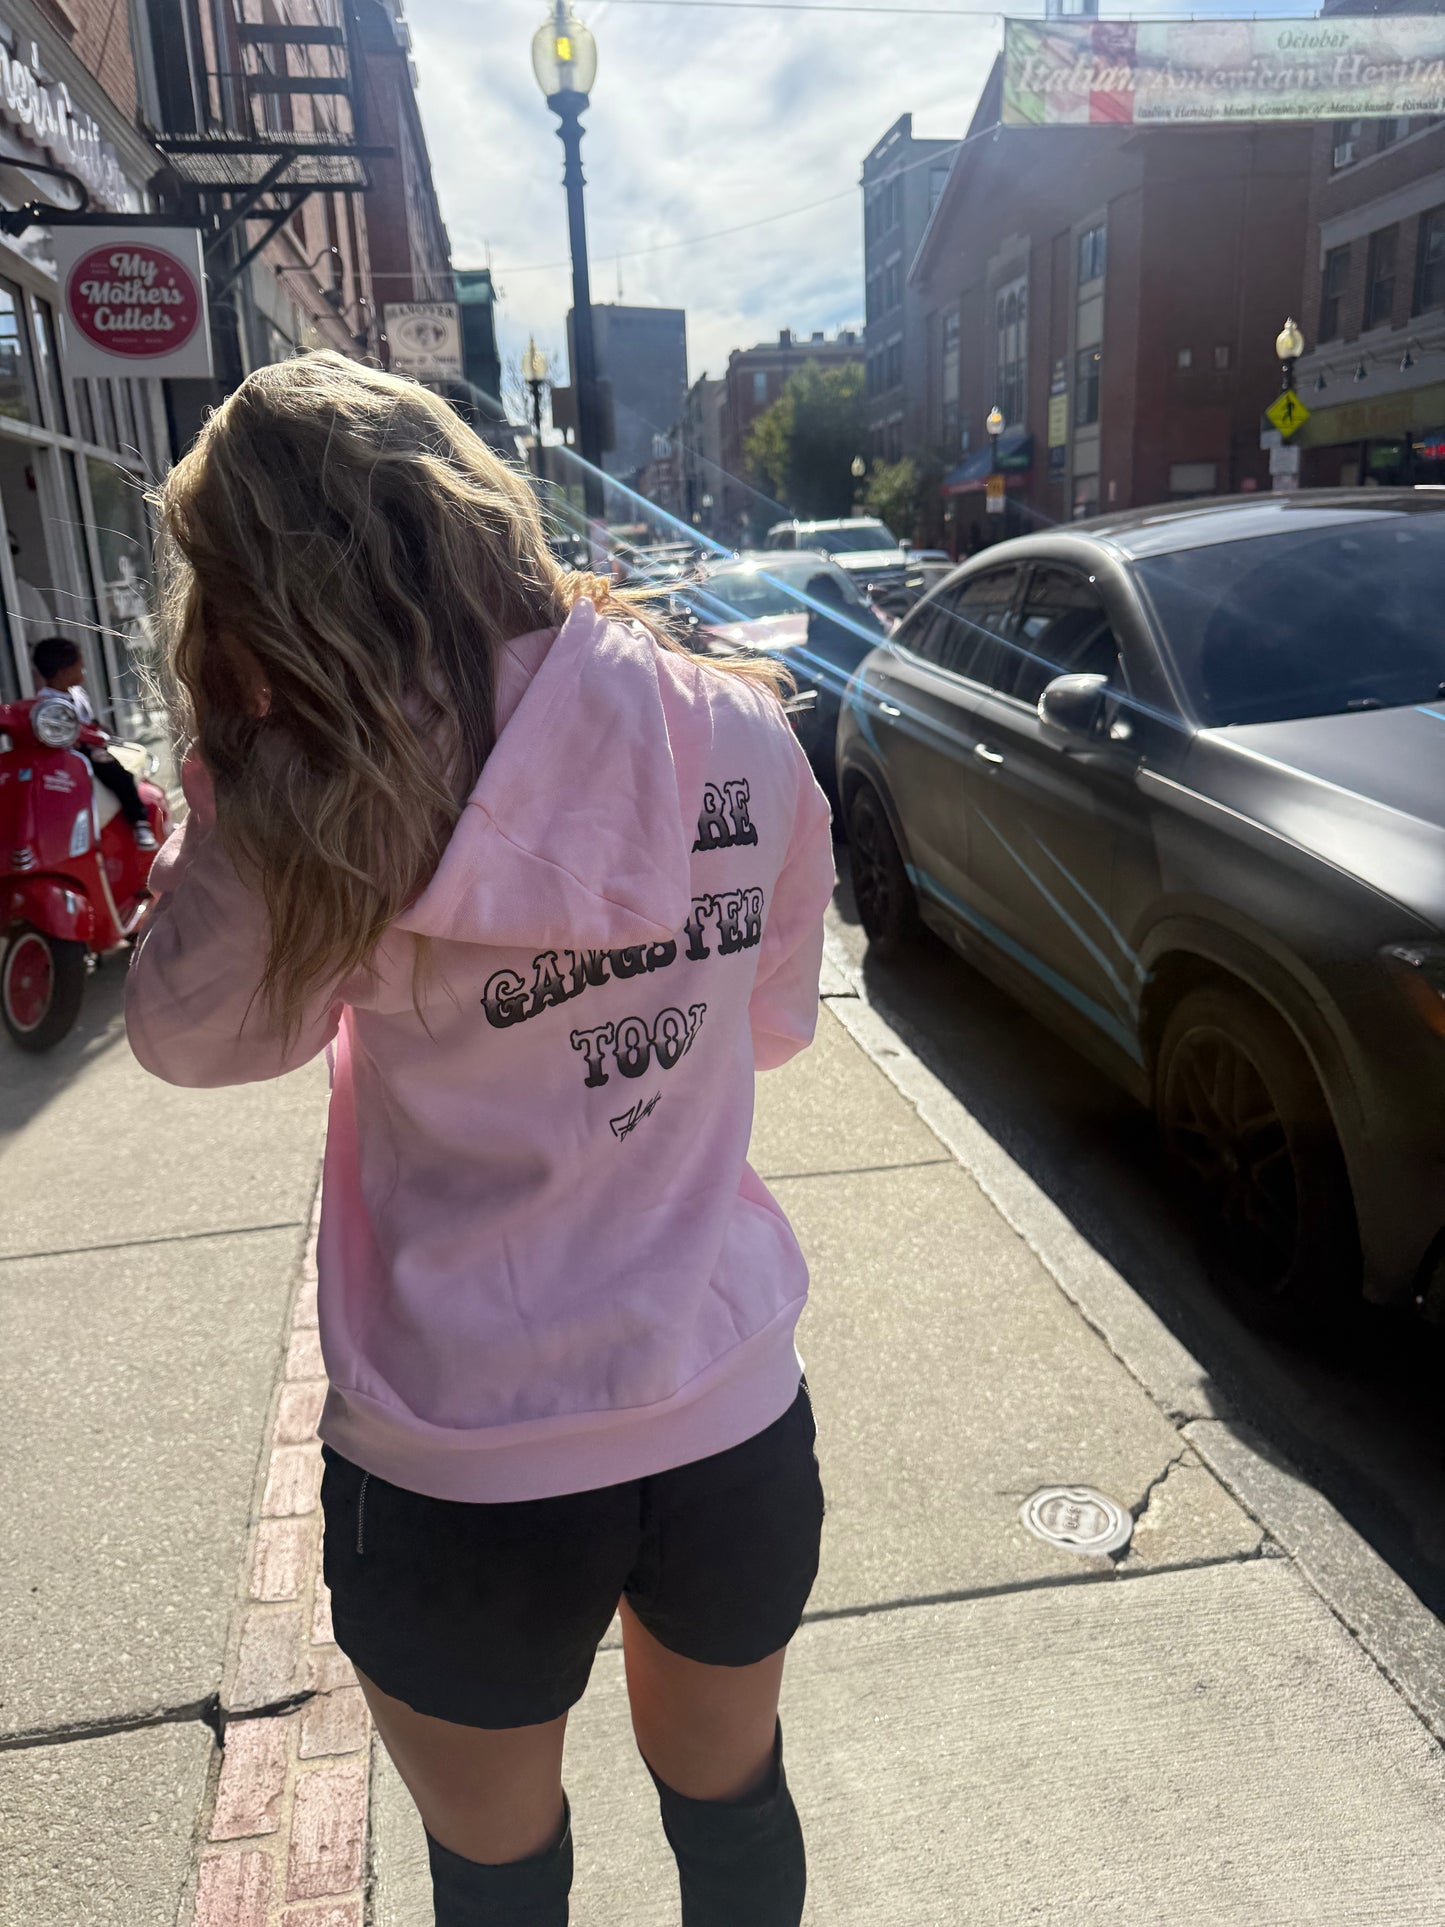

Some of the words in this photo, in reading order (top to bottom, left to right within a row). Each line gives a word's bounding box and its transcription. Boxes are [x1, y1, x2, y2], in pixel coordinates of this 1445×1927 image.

[1277, 29, 1349, 50] October
[1016, 54, 1137, 93] Italian
[1149, 59, 1317, 90] American
[109, 252, 158, 286] My
[79, 277, 184, 305] Mother's
[93, 306, 176, 332] Cutlets
[691, 777, 759, 853] RE
